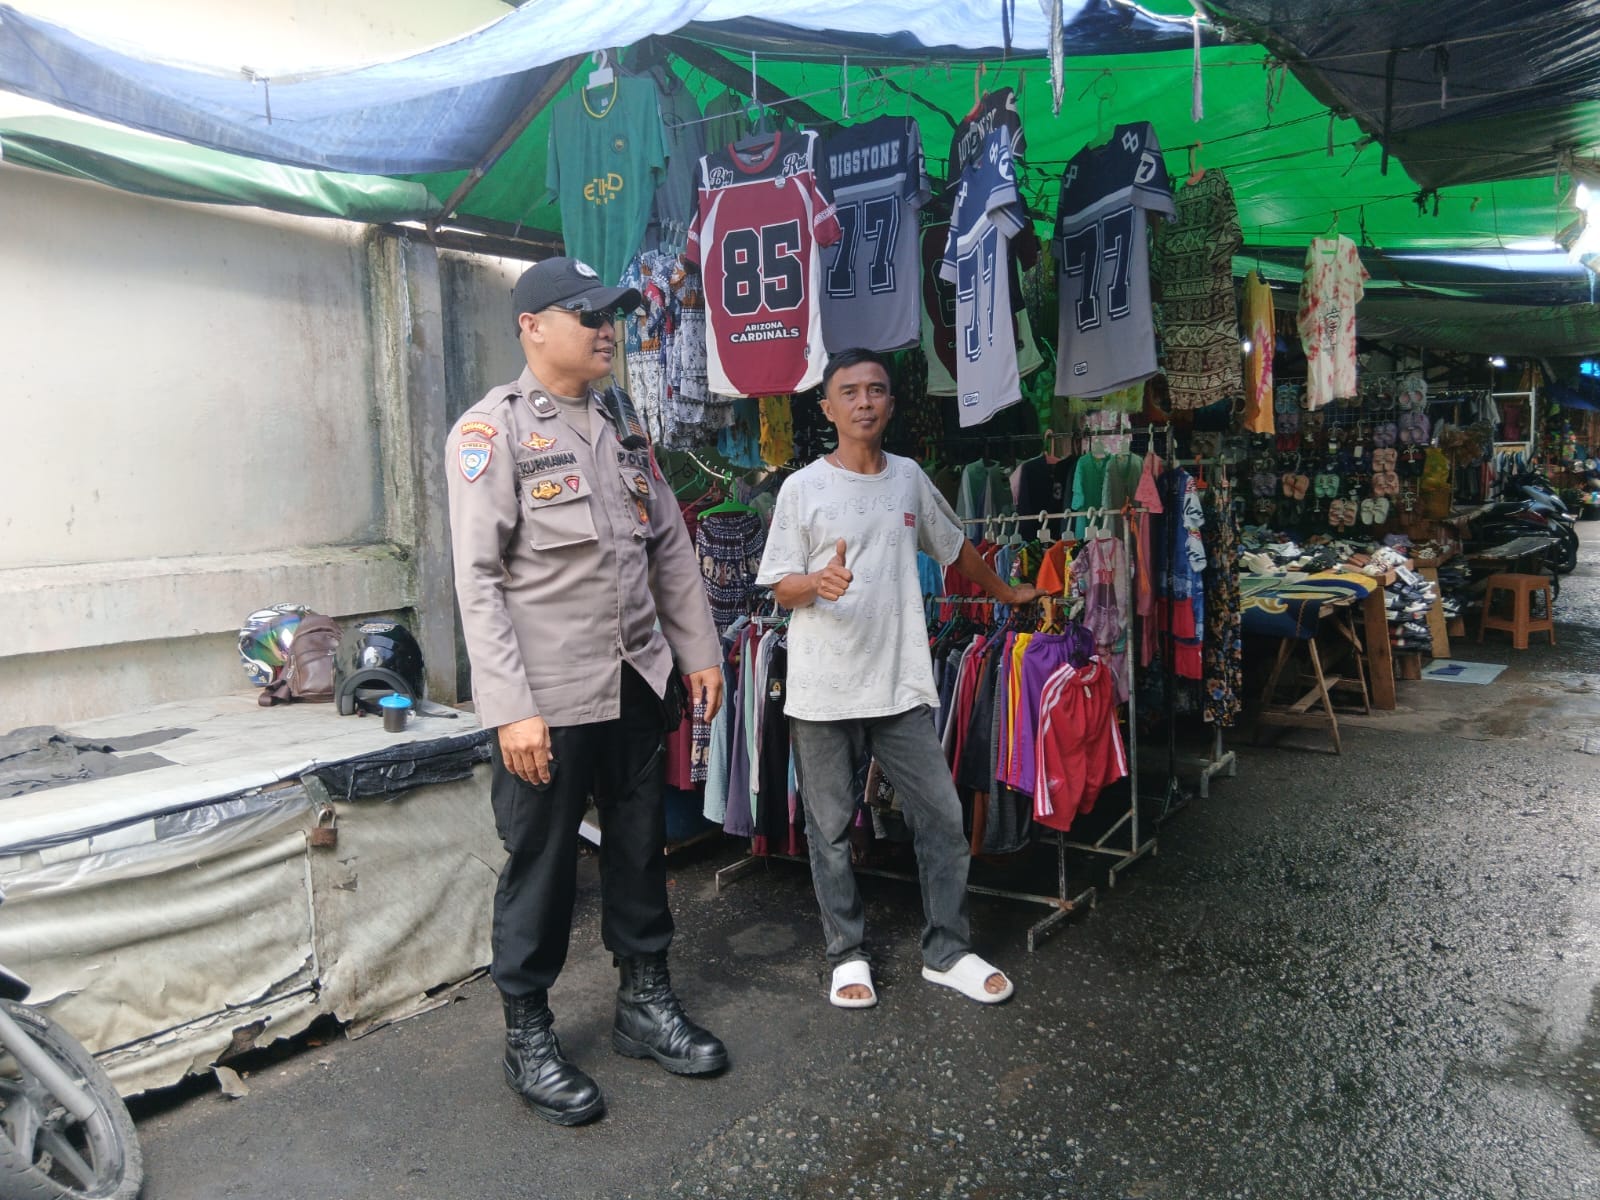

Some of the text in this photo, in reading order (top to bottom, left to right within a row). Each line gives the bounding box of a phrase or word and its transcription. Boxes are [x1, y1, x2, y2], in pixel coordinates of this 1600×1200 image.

[829, 140, 901, 180] BIGSTONE
[1141, 161, 1154, 180] 7
[825, 192, 900, 299] 77
[721, 218, 805, 317] 85
[1061, 205, 1136, 333] 77
[730, 328, 800, 343] CARDINALS
[744, 321, 784, 333] ARIZONA
